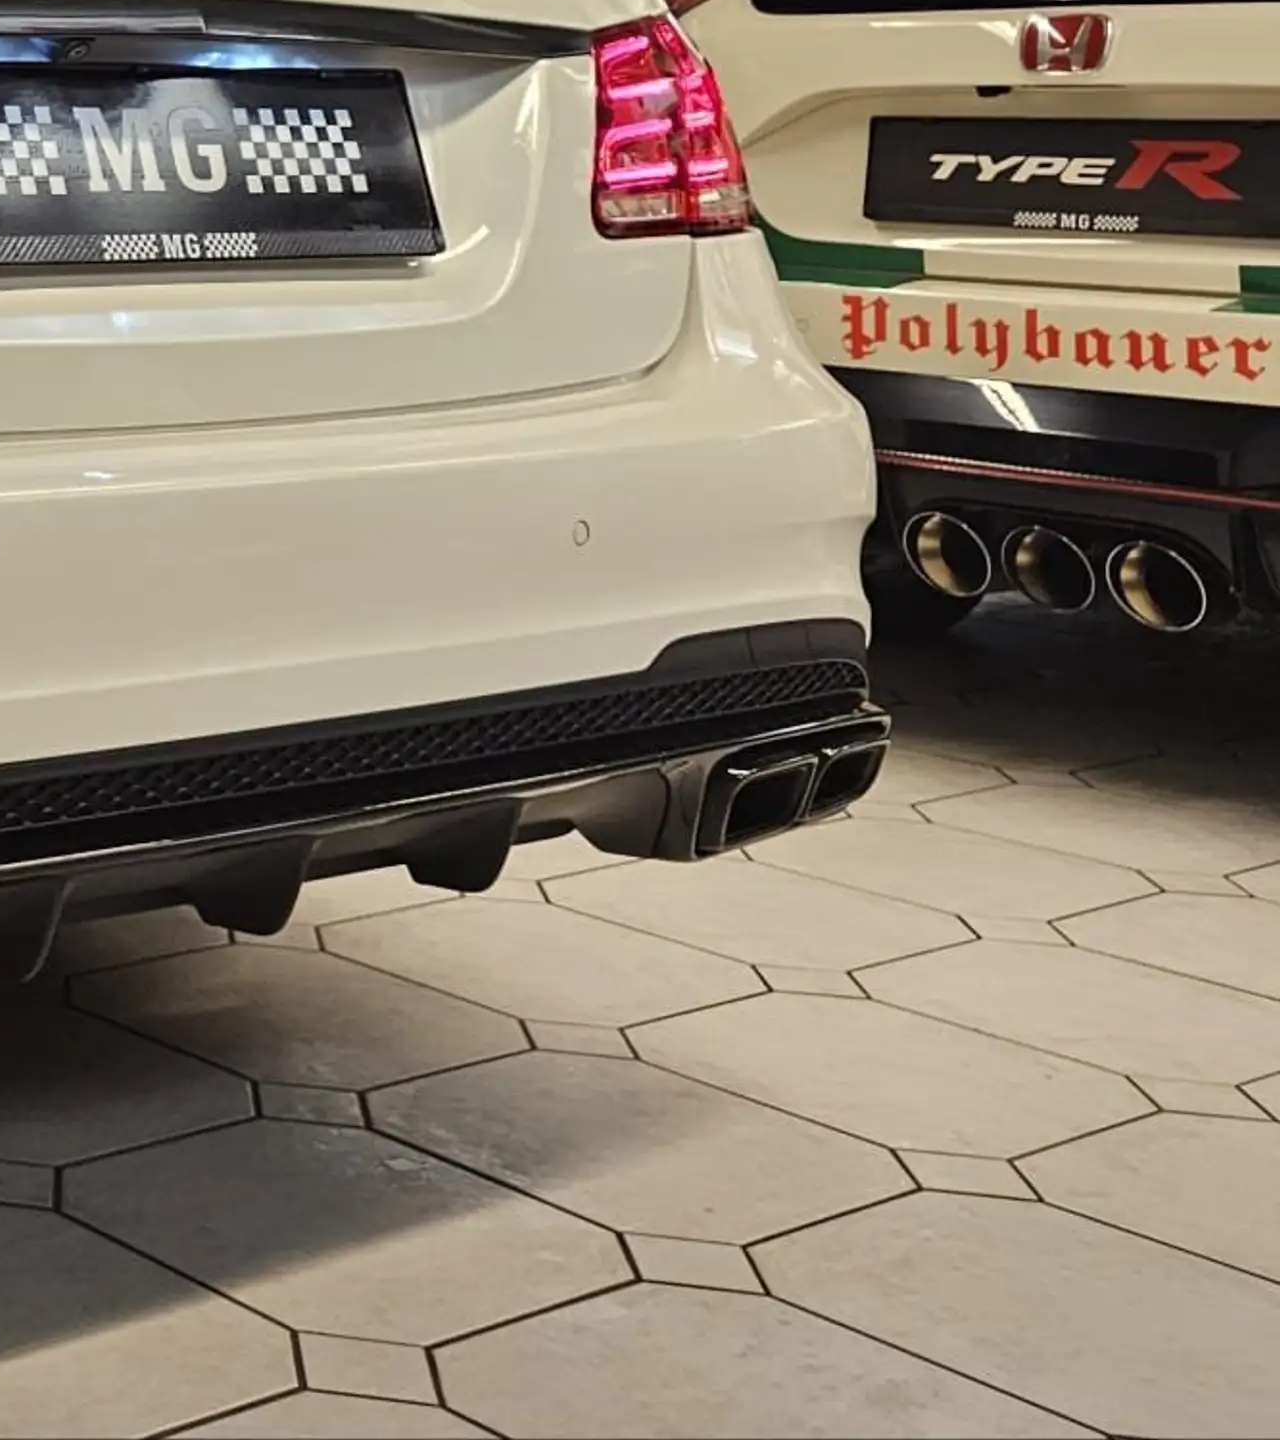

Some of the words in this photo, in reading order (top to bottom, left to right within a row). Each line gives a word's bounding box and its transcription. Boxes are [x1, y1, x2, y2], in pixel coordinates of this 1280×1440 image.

[72, 106, 228, 193] MG
[928, 153, 1117, 186] TYPE
[1113, 140, 1244, 201] R
[159, 233, 202, 259] MG
[1060, 214, 1091, 231] MG
[842, 293, 1273, 382] Polybauer
